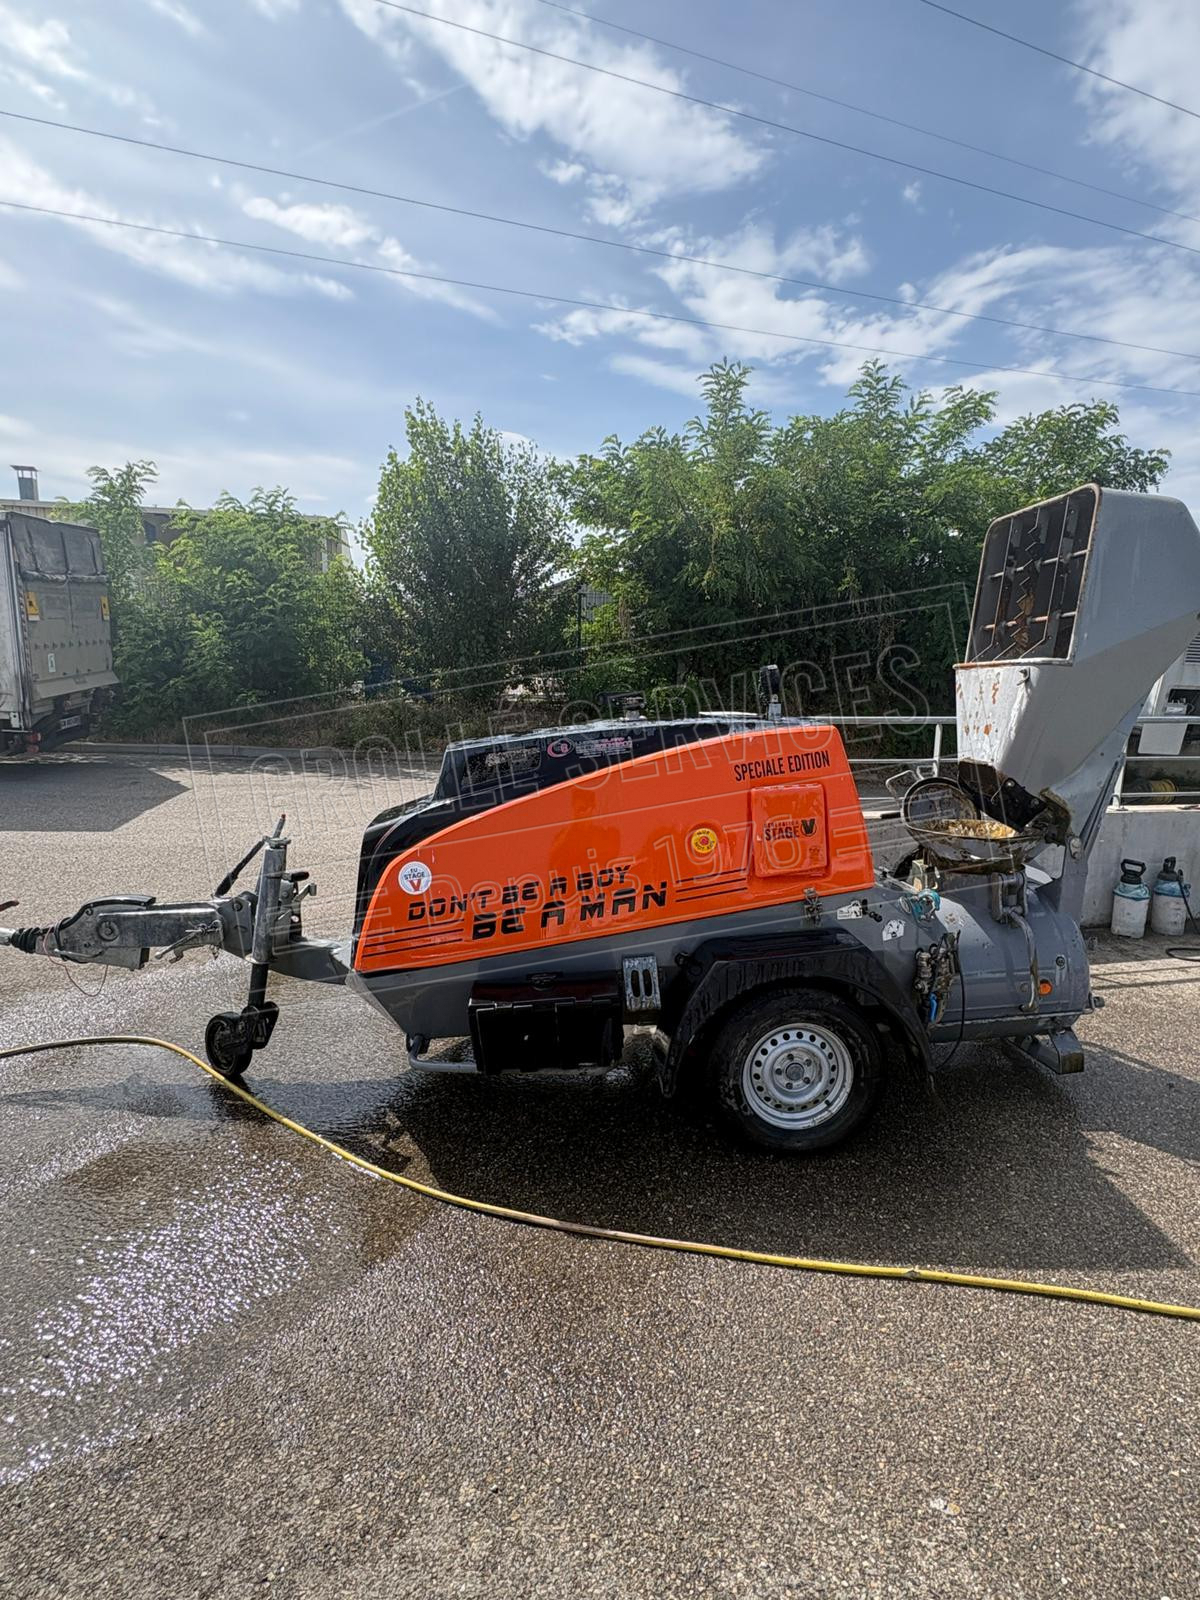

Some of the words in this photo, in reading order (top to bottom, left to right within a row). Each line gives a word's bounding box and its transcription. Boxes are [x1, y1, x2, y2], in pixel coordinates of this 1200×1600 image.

[734, 758, 785, 782] SPECIALE
[787, 750, 830, 773] EDITION
[765, 825, 800, 841] STAGE
[801, 818, 816, 835] V
[404, 871, 425, 880] STAGE
[409, 879, 421, 892] V
[408, 889, 492, 921] DON'T
[502, 881, 539, 905] BE
[550, 876, 567, 896] A
[577, 865, 631, 891] BOY
[472, 907, 526, 941] BE
[541, 900, 565, 929] A
[580, 881, 668, 922] MAN
